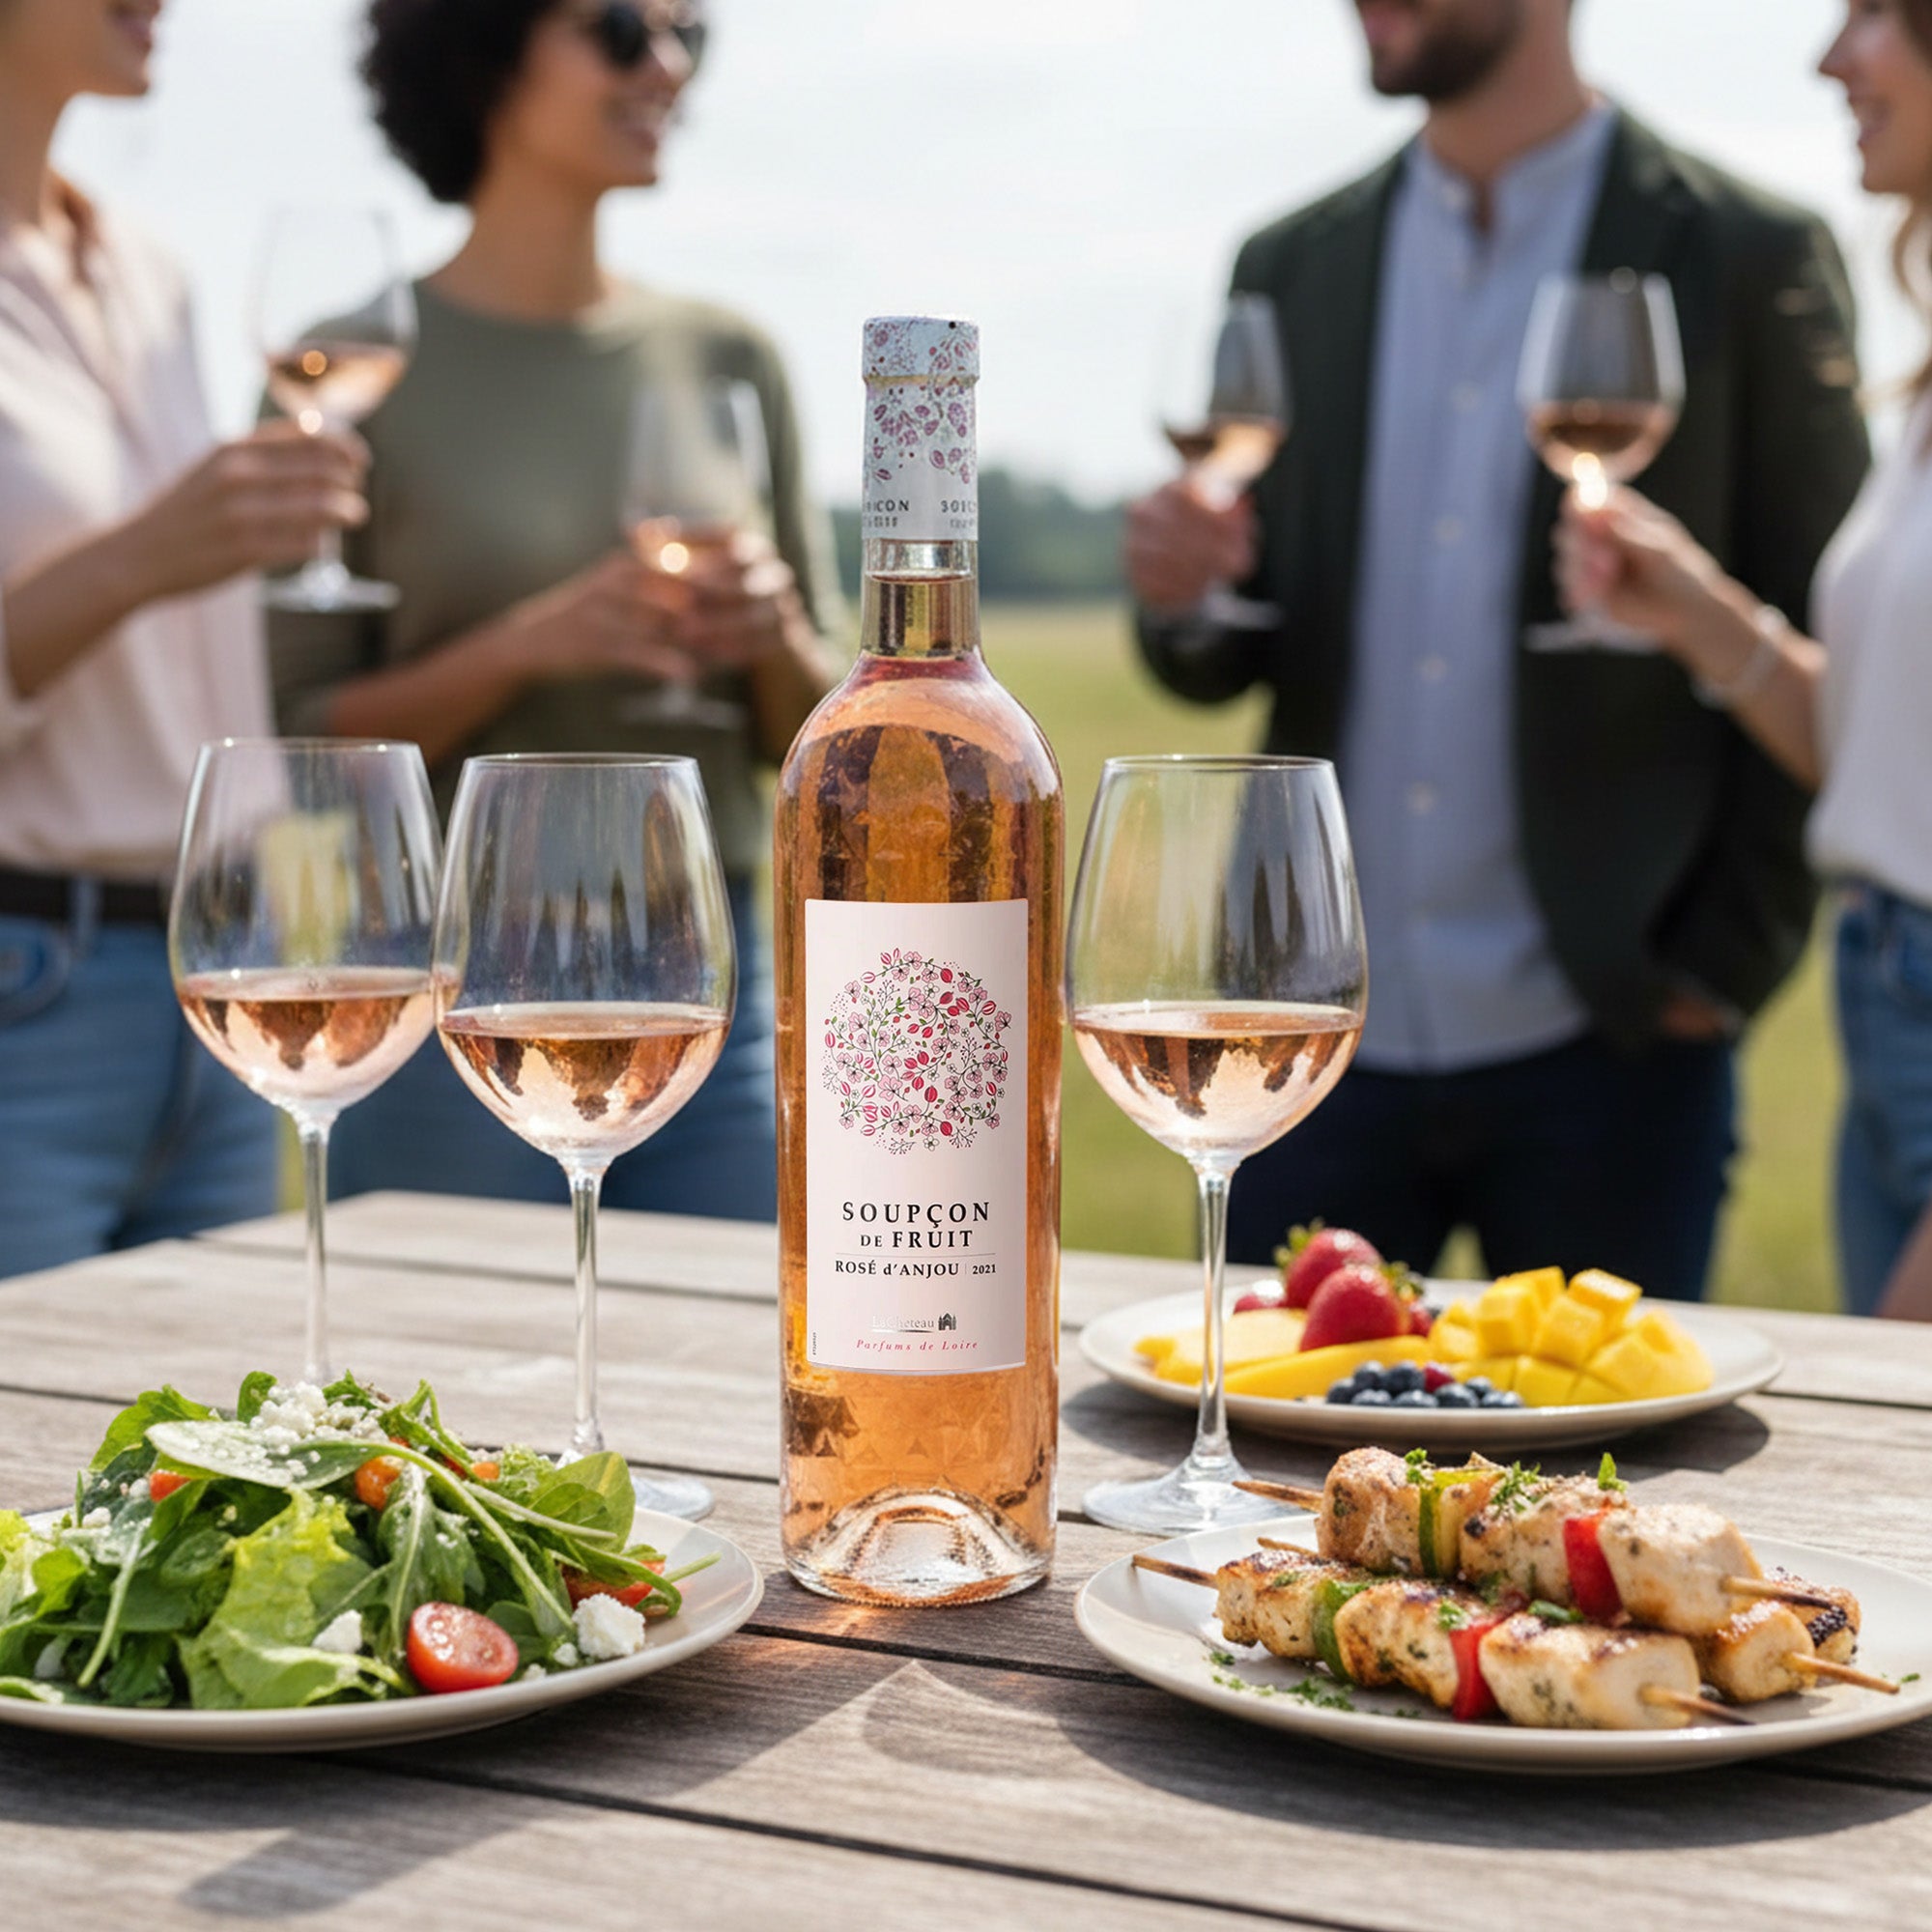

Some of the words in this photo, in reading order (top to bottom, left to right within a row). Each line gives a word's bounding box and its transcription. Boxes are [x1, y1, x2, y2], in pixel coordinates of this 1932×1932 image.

[842, 1201, 989, 1229] SOUPÇON
[860, 1234, 883, 1247] DE
[892, 1230, 973, 1248] FRUIT
[835, 1260, 877, 1275] ROSÉ
[883, 1263, 959, 1279] d'ANJOU
[972, 1264, 996, 1275] 2021
[856, 1339, 911, 1352] Parfums
[920, 1340, 934, 1350] de
[942, 1339, 979, 1350] Loire
